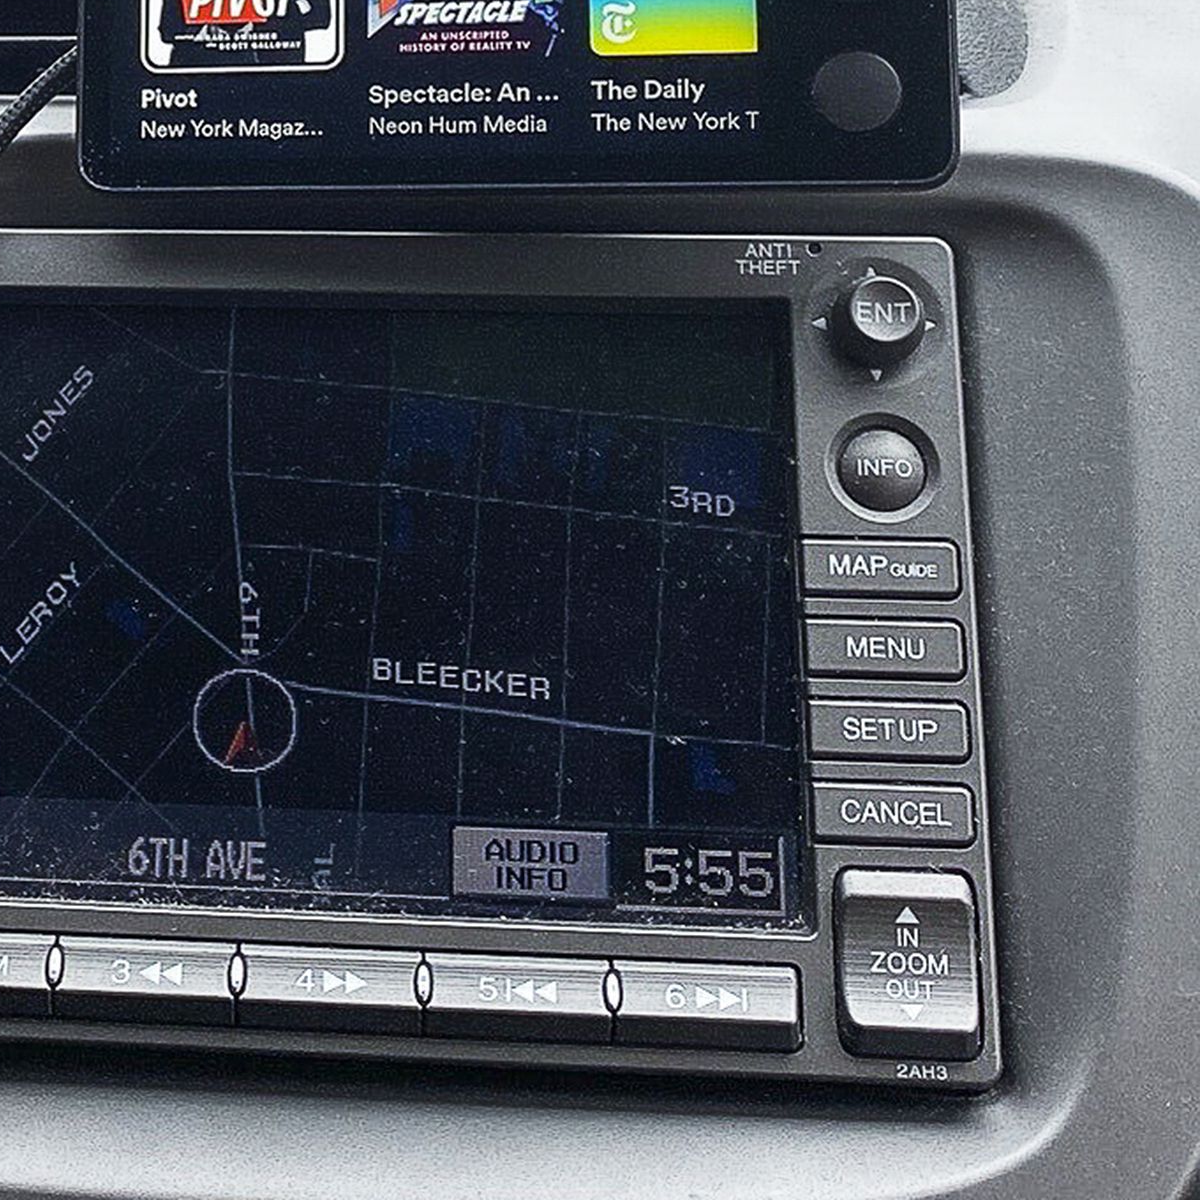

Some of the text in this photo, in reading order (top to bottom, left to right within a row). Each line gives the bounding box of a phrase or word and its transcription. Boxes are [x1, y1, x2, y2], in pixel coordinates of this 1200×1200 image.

[393, 0, 530, 26] SPECTACLE
[399, 40, 531, 53] HISTORY OF REALITY TV
[420, 30, 510, 41] AN UNSCRIPTED
[140, 88, 198, 108] Pivot
[368, 83, 491, 109] Spectacle:
[497, 82, 530, 102] An
[591, 78, 705, 104] The Daily
[140, 118, 323, 141] New York Magaz...
[368, 114, 548, 136] Neon Hum Media
[591, 111, 760, 132] The New York T
[745, 243, 792, 259] ANTI
[735, 259, 801, 275] THEFT
[856, 302, 911, 324] ENT
[22, 365, 94, 462] JONES
[856, 458, 914, 478] INFO
[669, 485, 735, 517] 3RD
[828, 554, 939, 578] MAP GUIDE
[0, 561, 80, 664] LEROY
[846, 636, 926, 660] MENU
[372, 657, 550, 701] BLEECKER
[841, 799, 953, 827] CANCEL
[128, 836, 189, 878] 6TH
[205, 838, 267, 882] AVE
[484, 838, 580, 865] AUDIO
[495, 865, 569, 892] INFO
[644, 847, 775, 898] 5:55
[896, 927, 919, 948] IN
[111, 958, 132, 983] 3
[869, 951, 949, 976] ZOOM
[293, 967, 315, 992] 4
[478, 977, 498, 1002] 5
[886, 979, 935, 1001] OUT
[665, 984, 687, 1008] 6
[896, 1063, 949, 1081] 2AH3
